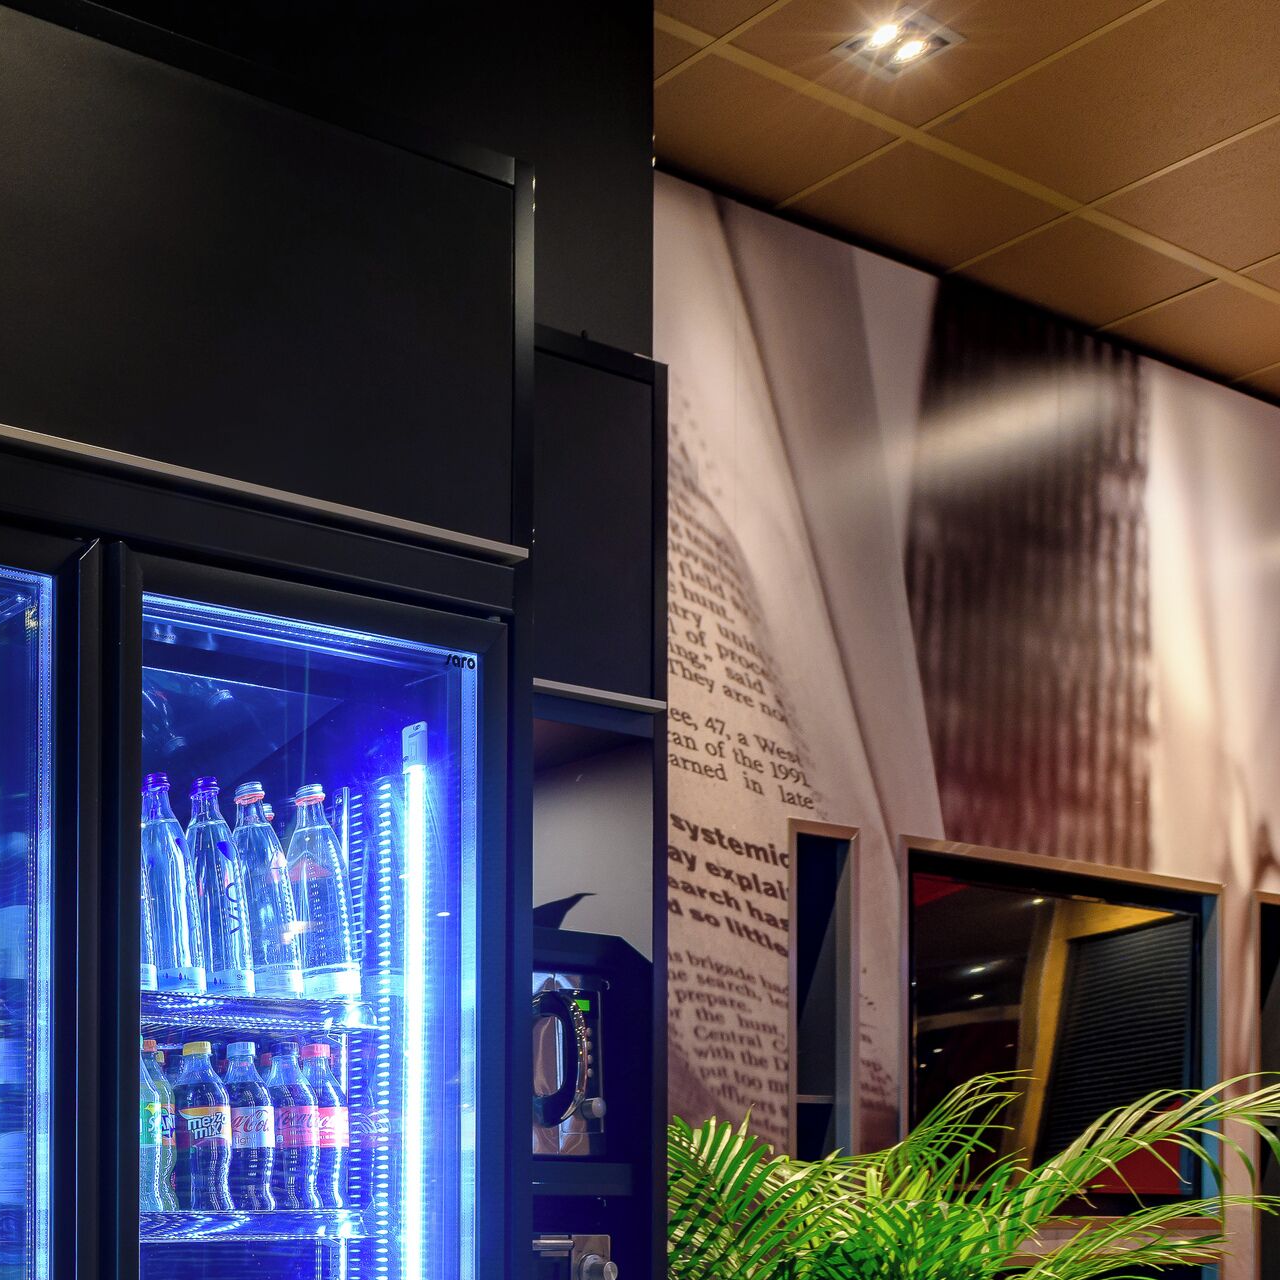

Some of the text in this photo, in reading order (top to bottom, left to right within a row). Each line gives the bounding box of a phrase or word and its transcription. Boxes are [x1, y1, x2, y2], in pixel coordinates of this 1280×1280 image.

[686, 631, 707, 648] of
[725, 666, 766, 695] said
[722, 684, 755, 708] are
[705, 716, 750, 747] 47, a
[705, 741, 812, 789] of the 1991
[742, 770, 815, 810] in late
[689, 908, 789, 958] so little
[686, 950, 756, 985] brigade
[696, 1008, 725, 1025] the
[694, 1025, 763, 1049] Central
[694, 1046, 769, 1069] with the
[734, 1070, 764, 1090] too
[192, 1126, 222, 1140] mix
